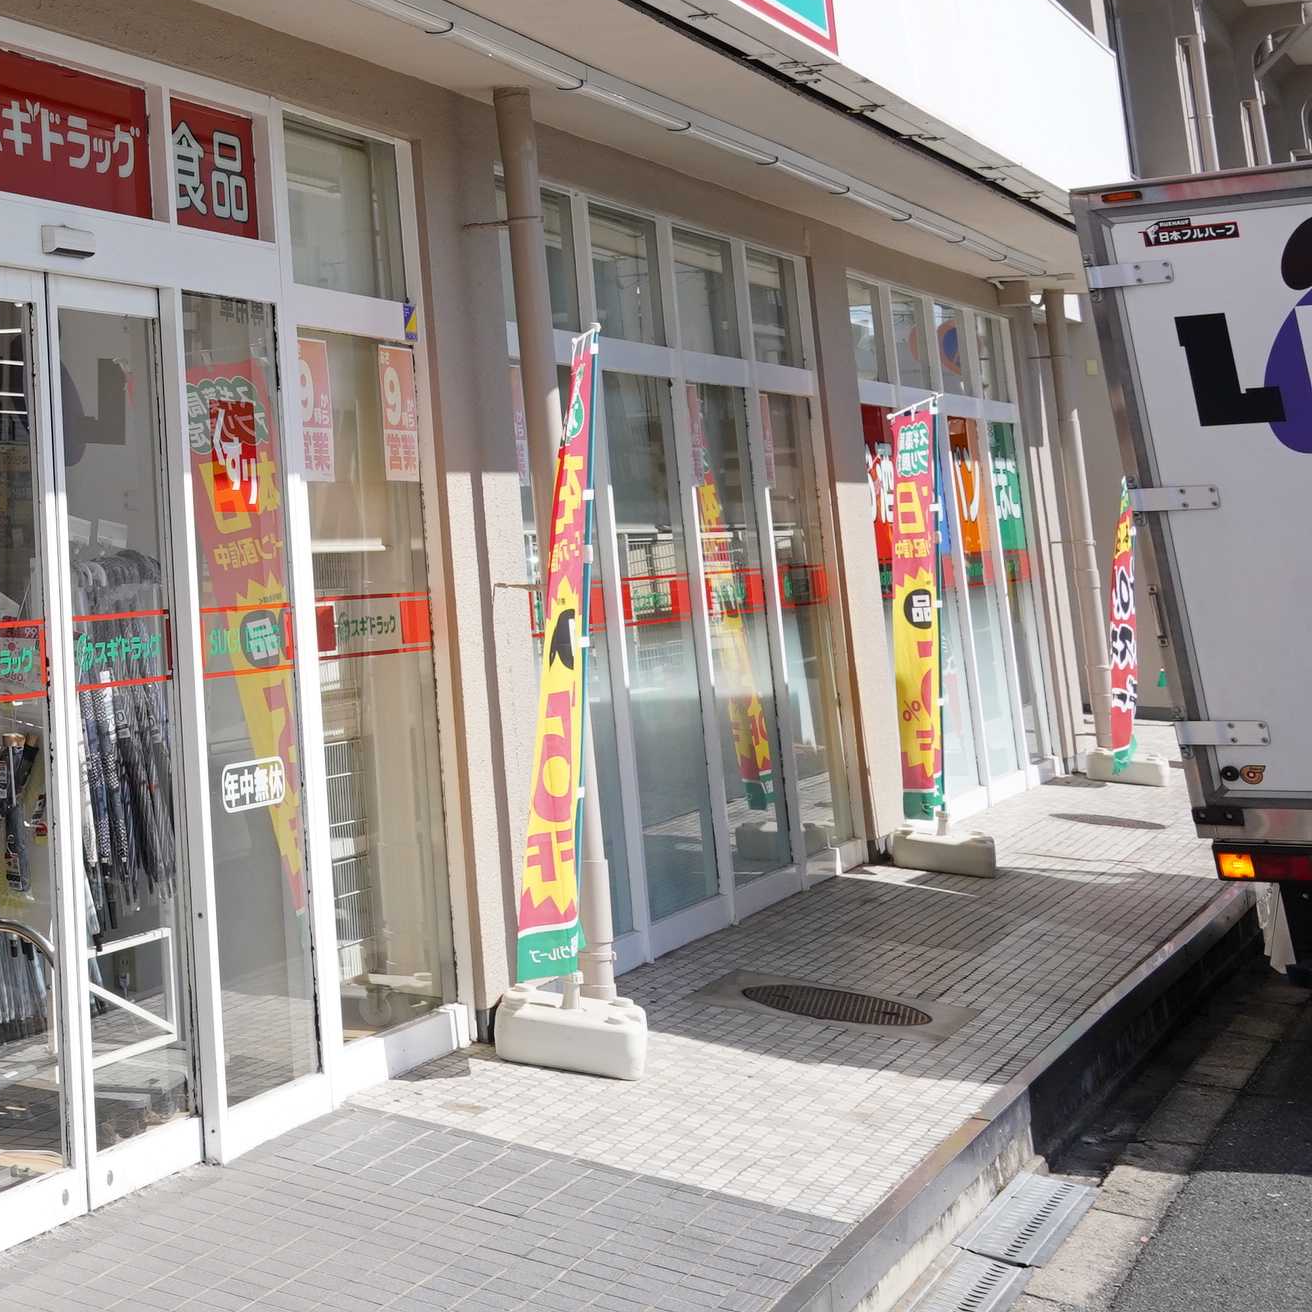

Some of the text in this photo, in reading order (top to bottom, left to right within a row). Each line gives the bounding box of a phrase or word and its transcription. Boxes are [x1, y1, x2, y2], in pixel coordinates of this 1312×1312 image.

[171, 121, 249, 223] 食品
[1158, 224, 1236, 243] 日本フルハーフ
[212, 408, 258, 505] くすり
[350, 615, 397, 636] スギドラッグ
[95, 633, 161, 667] スギドラッグ
[224, 763, 284, 808] 年中無休
